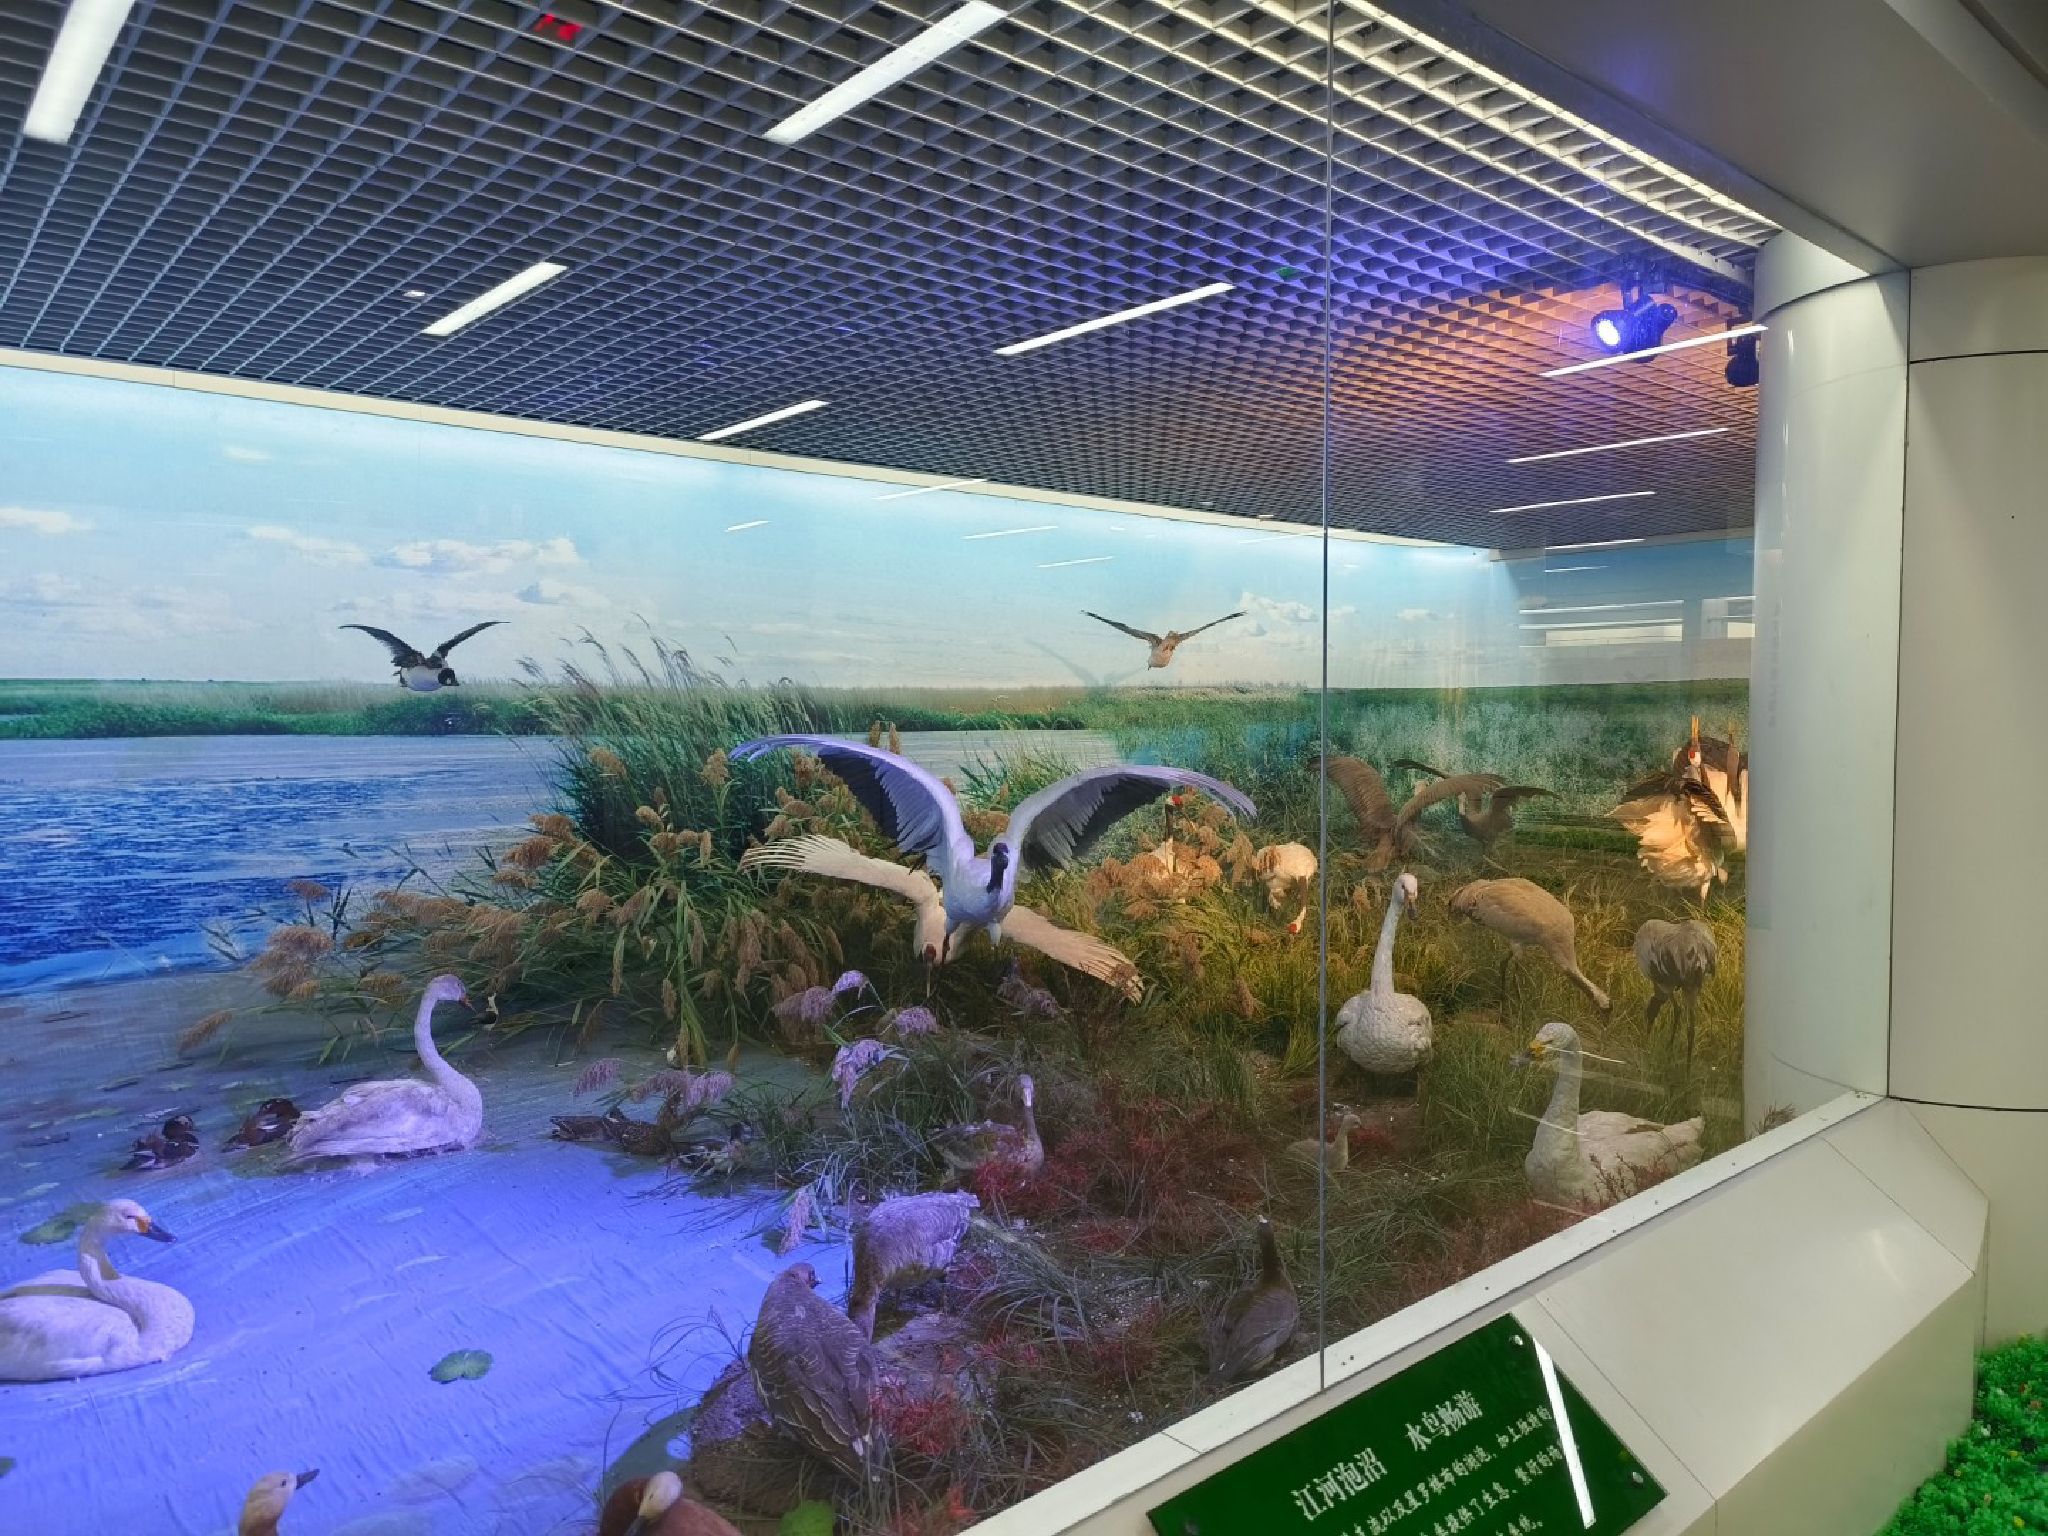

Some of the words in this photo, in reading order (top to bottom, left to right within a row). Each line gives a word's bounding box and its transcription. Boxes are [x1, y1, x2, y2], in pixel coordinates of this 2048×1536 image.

[1291, 1448, 1388, 1521] 江河泡沼
[1405, 1390, 1483, 1451] 水鸟畅游
